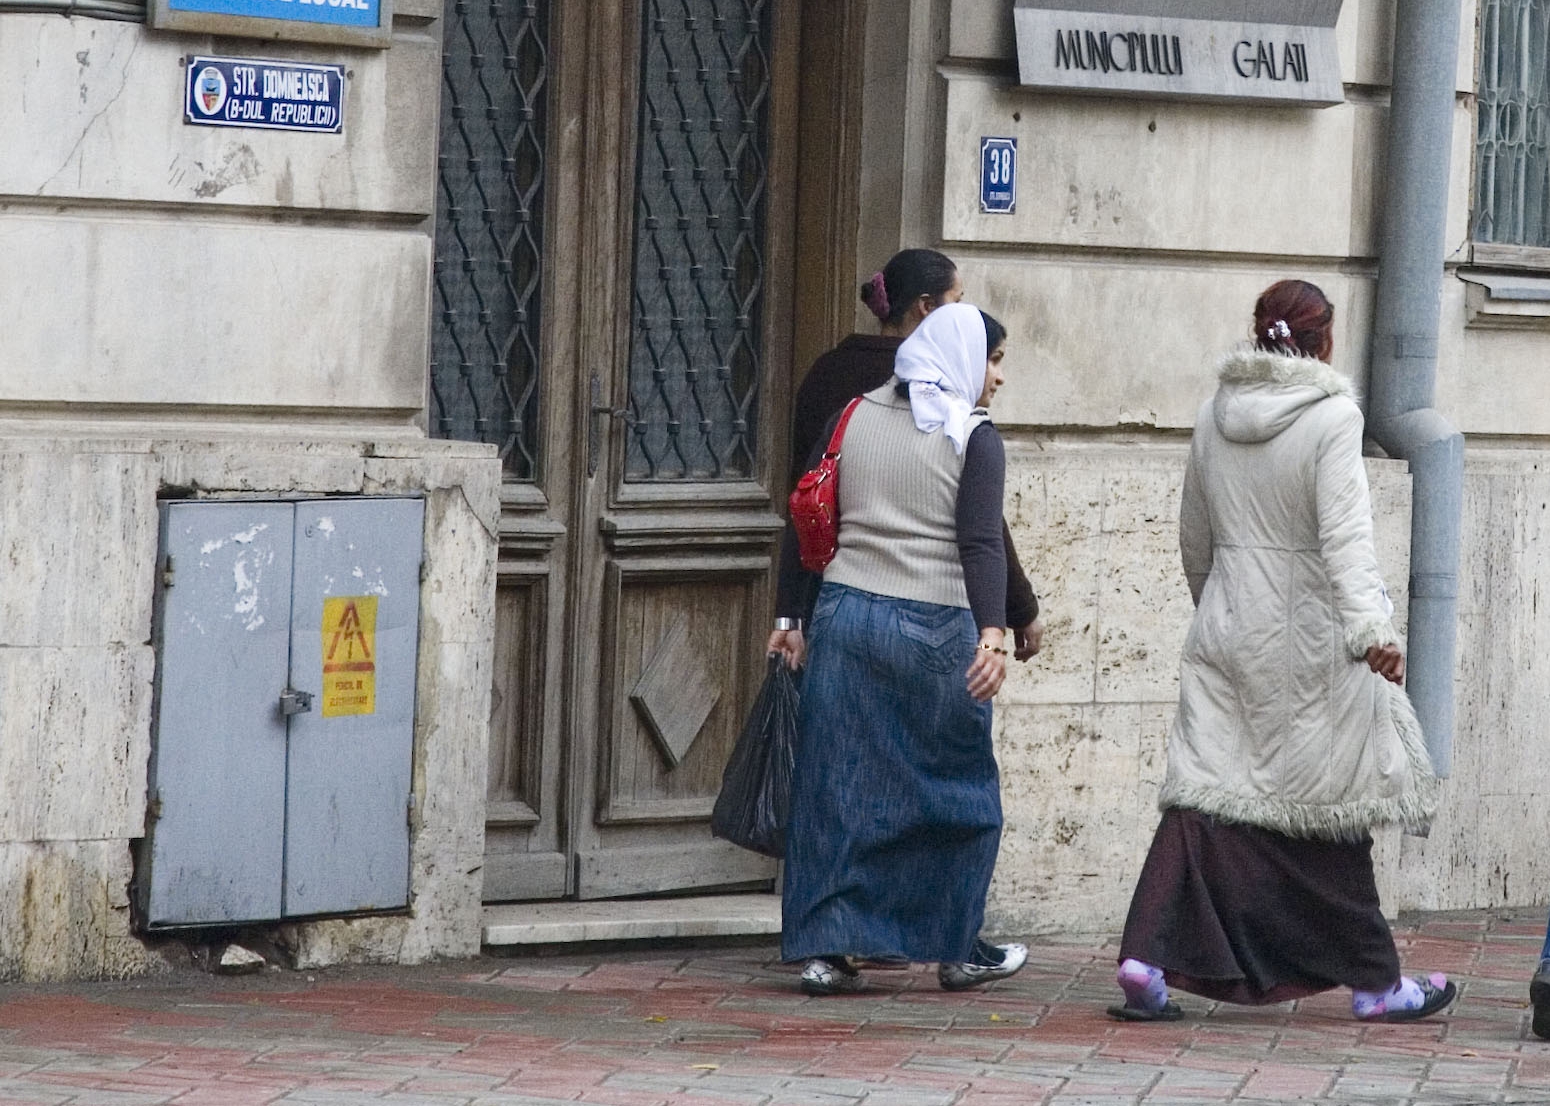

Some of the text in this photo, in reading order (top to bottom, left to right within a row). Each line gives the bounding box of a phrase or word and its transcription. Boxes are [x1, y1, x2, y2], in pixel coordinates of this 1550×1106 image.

[1232, 40, 1309, 83] GALATI
[233, 66, 259, 97] STR.
[990, 148, 1011, 184] 38
